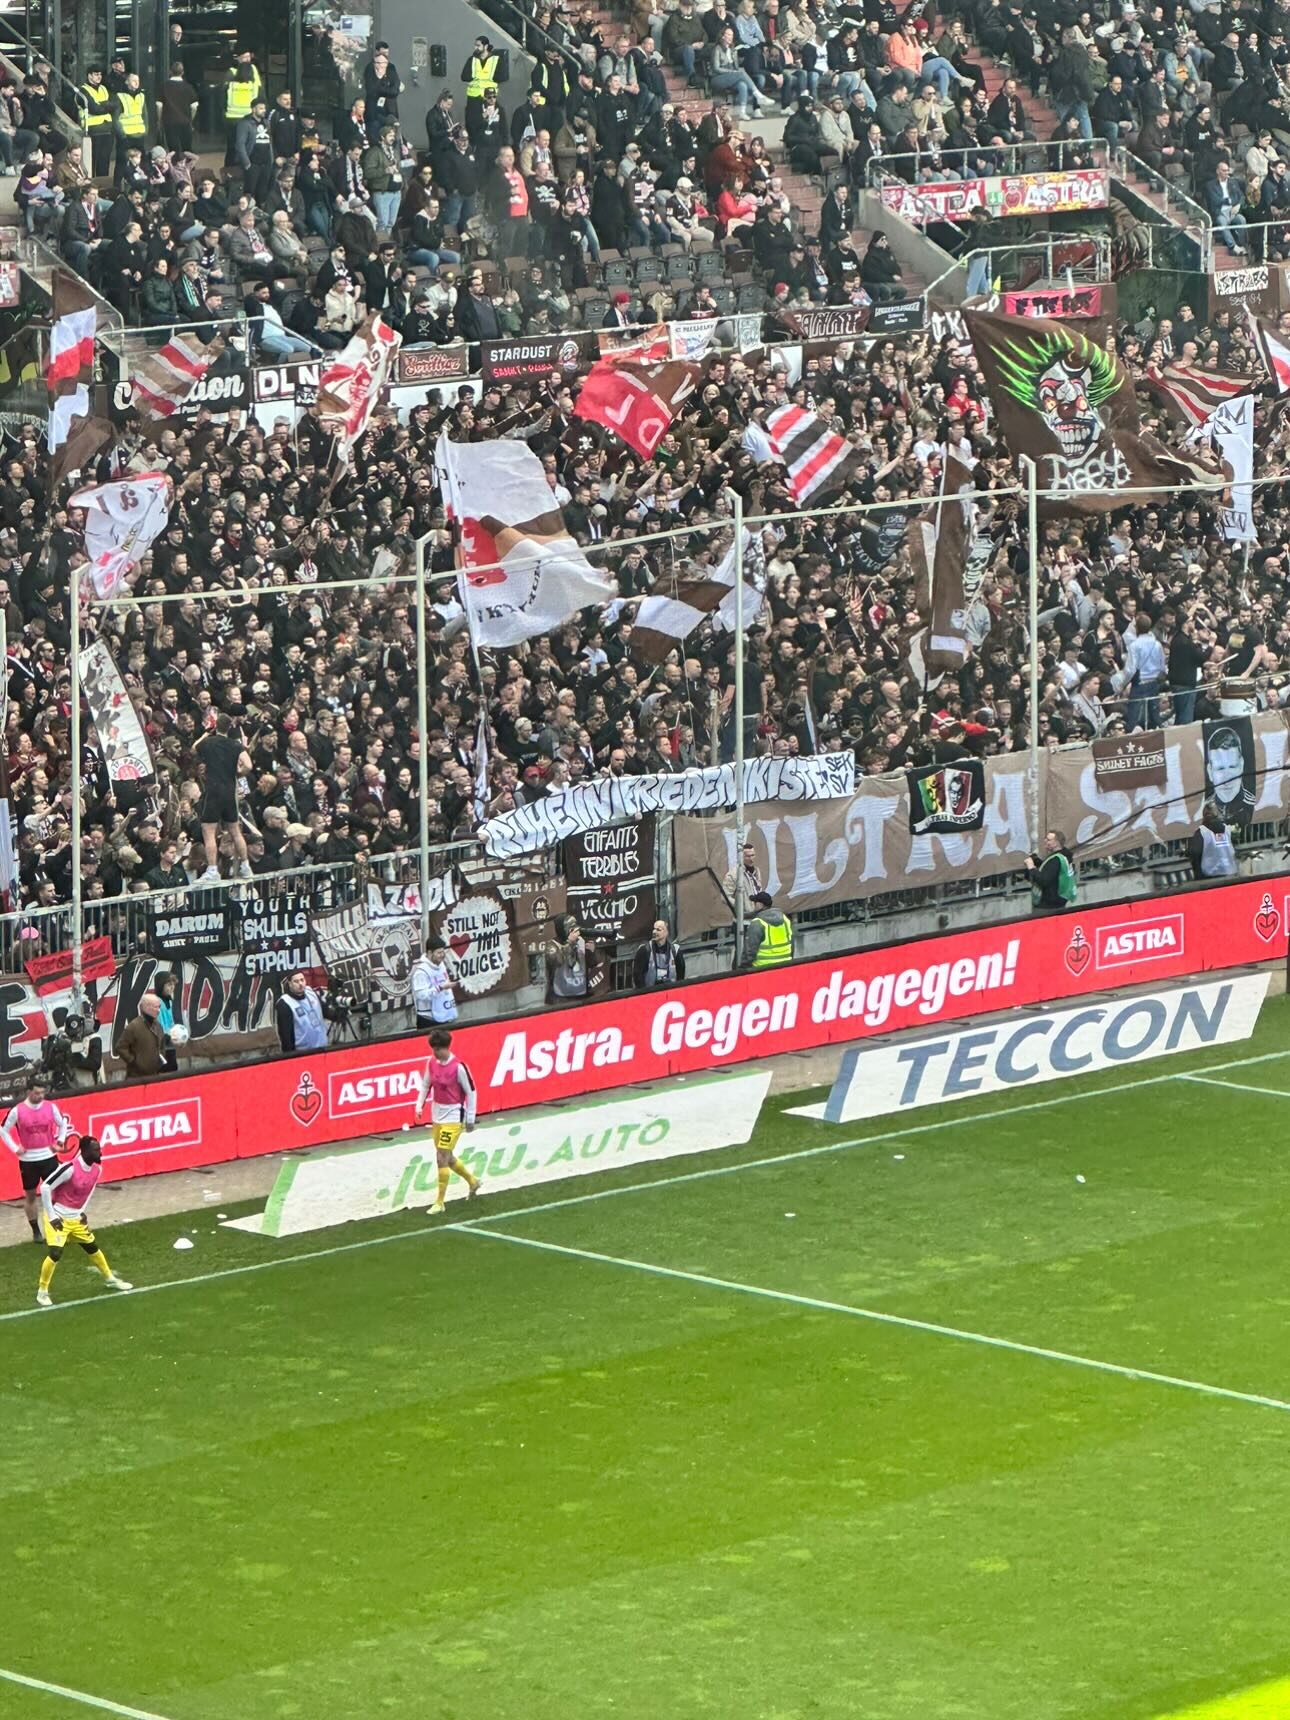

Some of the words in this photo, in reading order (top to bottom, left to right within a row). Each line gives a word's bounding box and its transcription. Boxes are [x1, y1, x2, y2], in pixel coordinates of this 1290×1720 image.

[1023, 180, 1106, 207] ASTRA
[490, 345, 552, 362] STARDUST
[584, 825, 638, 852] ENFANTS
[240, 895, 310, 917] YOUTH
[156, 913, 224, 937] DARUM
[243, 912, 307, 941] SKULLS
[448, 916, 479, 934] STILL
[482, 911, 500, 928] NOT
[1104, 926, 1176, 957] ASTRA
[489, 1027, 635, 1087] Astra.
[651, 1001, 799, 1056] Gegen
[811, 940, 1020, 1027] dagegen!
[896, 984, 1234, 1105] TECCON
[338, 1071, 423, 1105] ASTRA
[100, 1112, 192, 1147] ASTRA
[544, 1118, 671, 1167] AUTO
